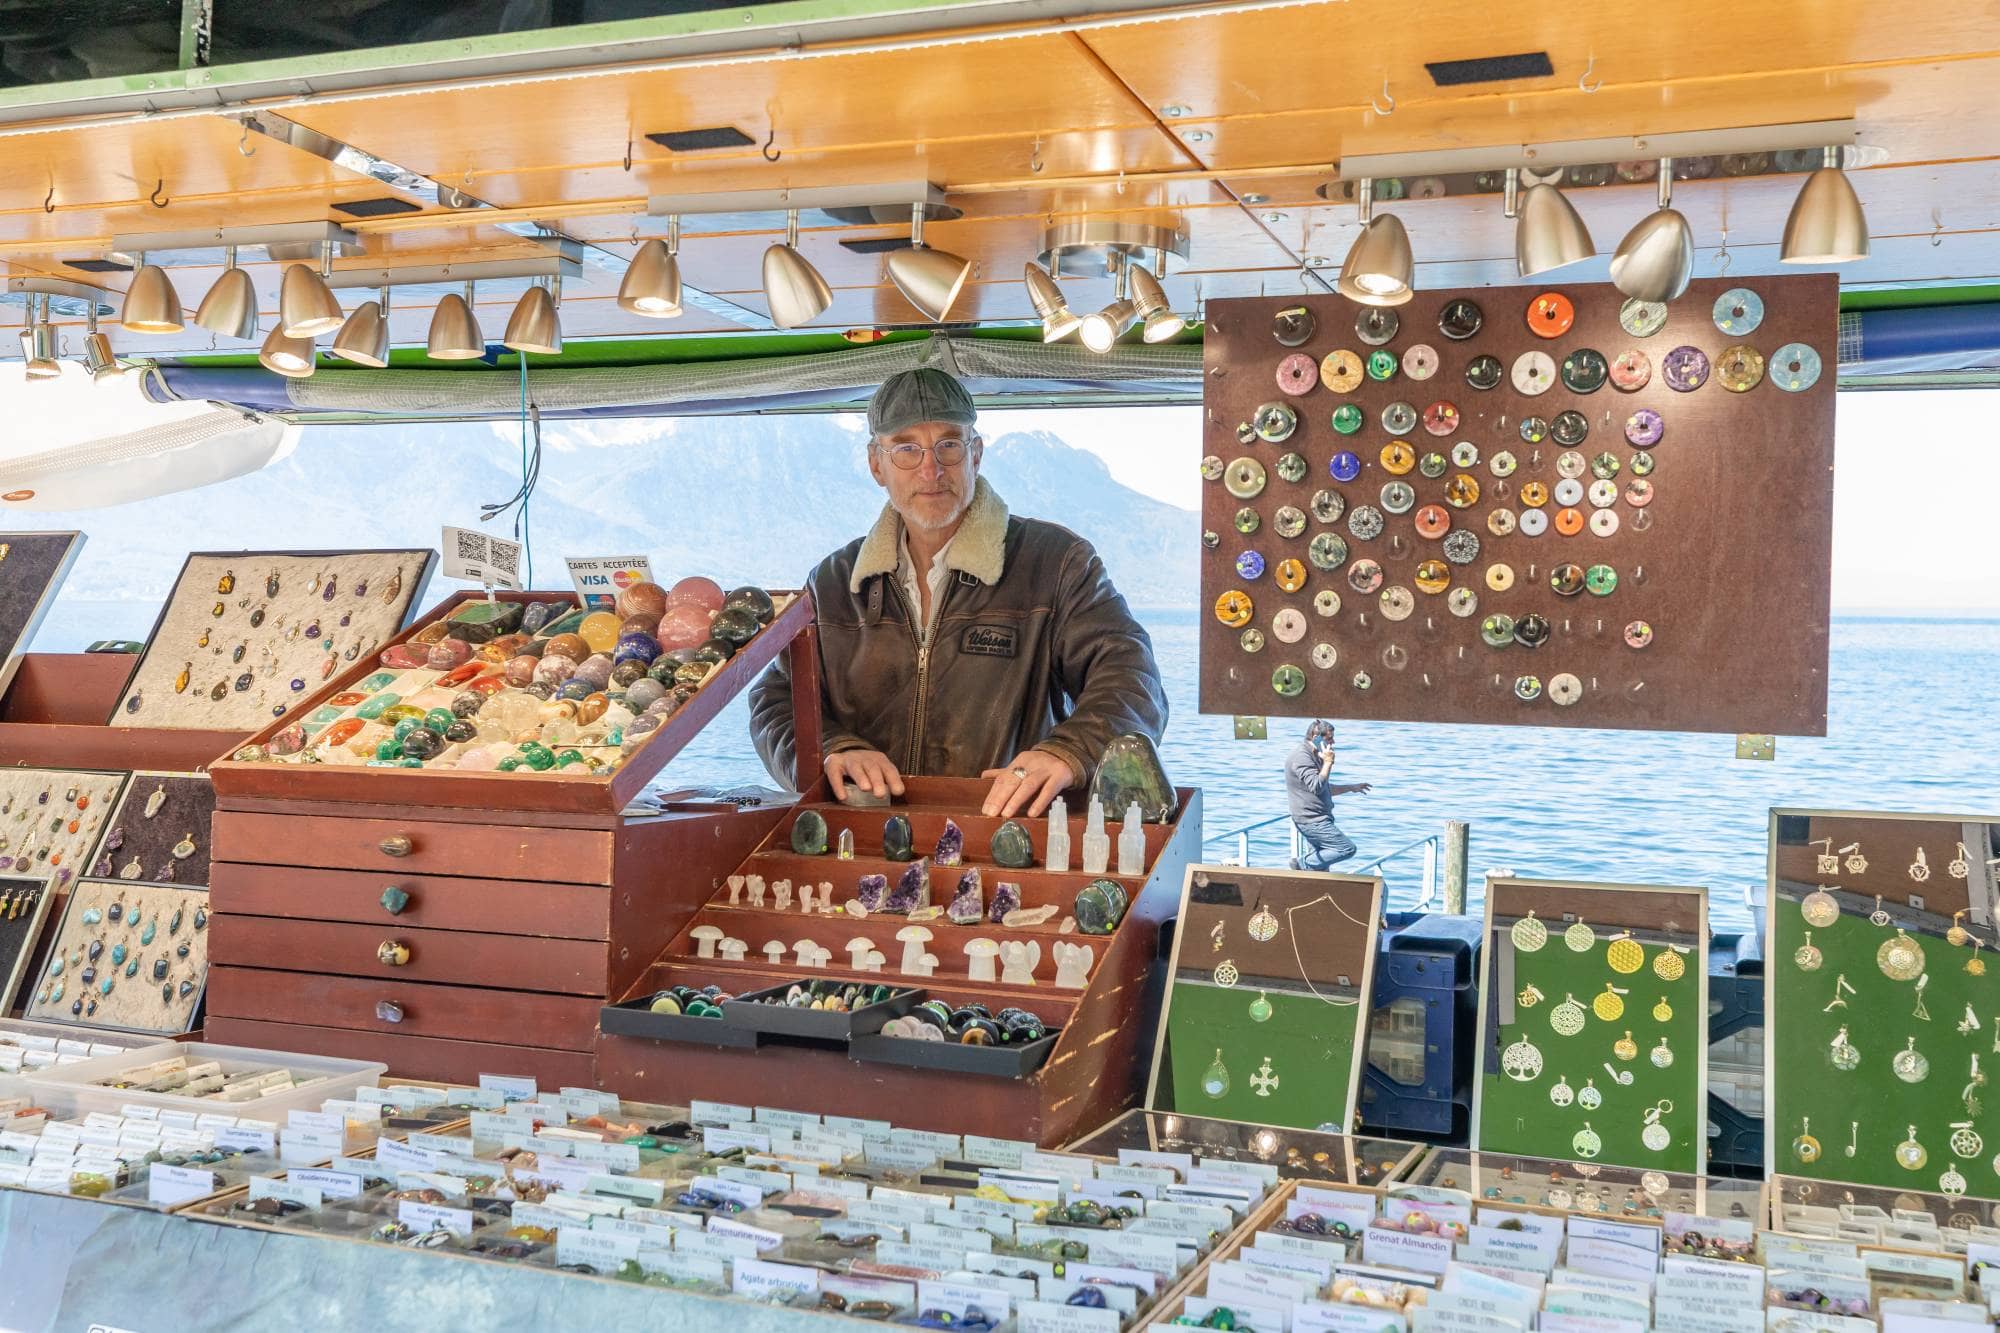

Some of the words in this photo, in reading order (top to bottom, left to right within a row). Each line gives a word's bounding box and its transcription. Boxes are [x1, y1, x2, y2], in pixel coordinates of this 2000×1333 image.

[603, 559, 648, 569] ACCEPTÉES
[579, 575, 609, 585] VISA
[710, 1225, 753, 1242] Aventurine
[1368, 1231, 1401, 1245] Grenat
[1402, 1237, 1447, 1251] Almandin
[740, 1272, 766, 1285] Agate
